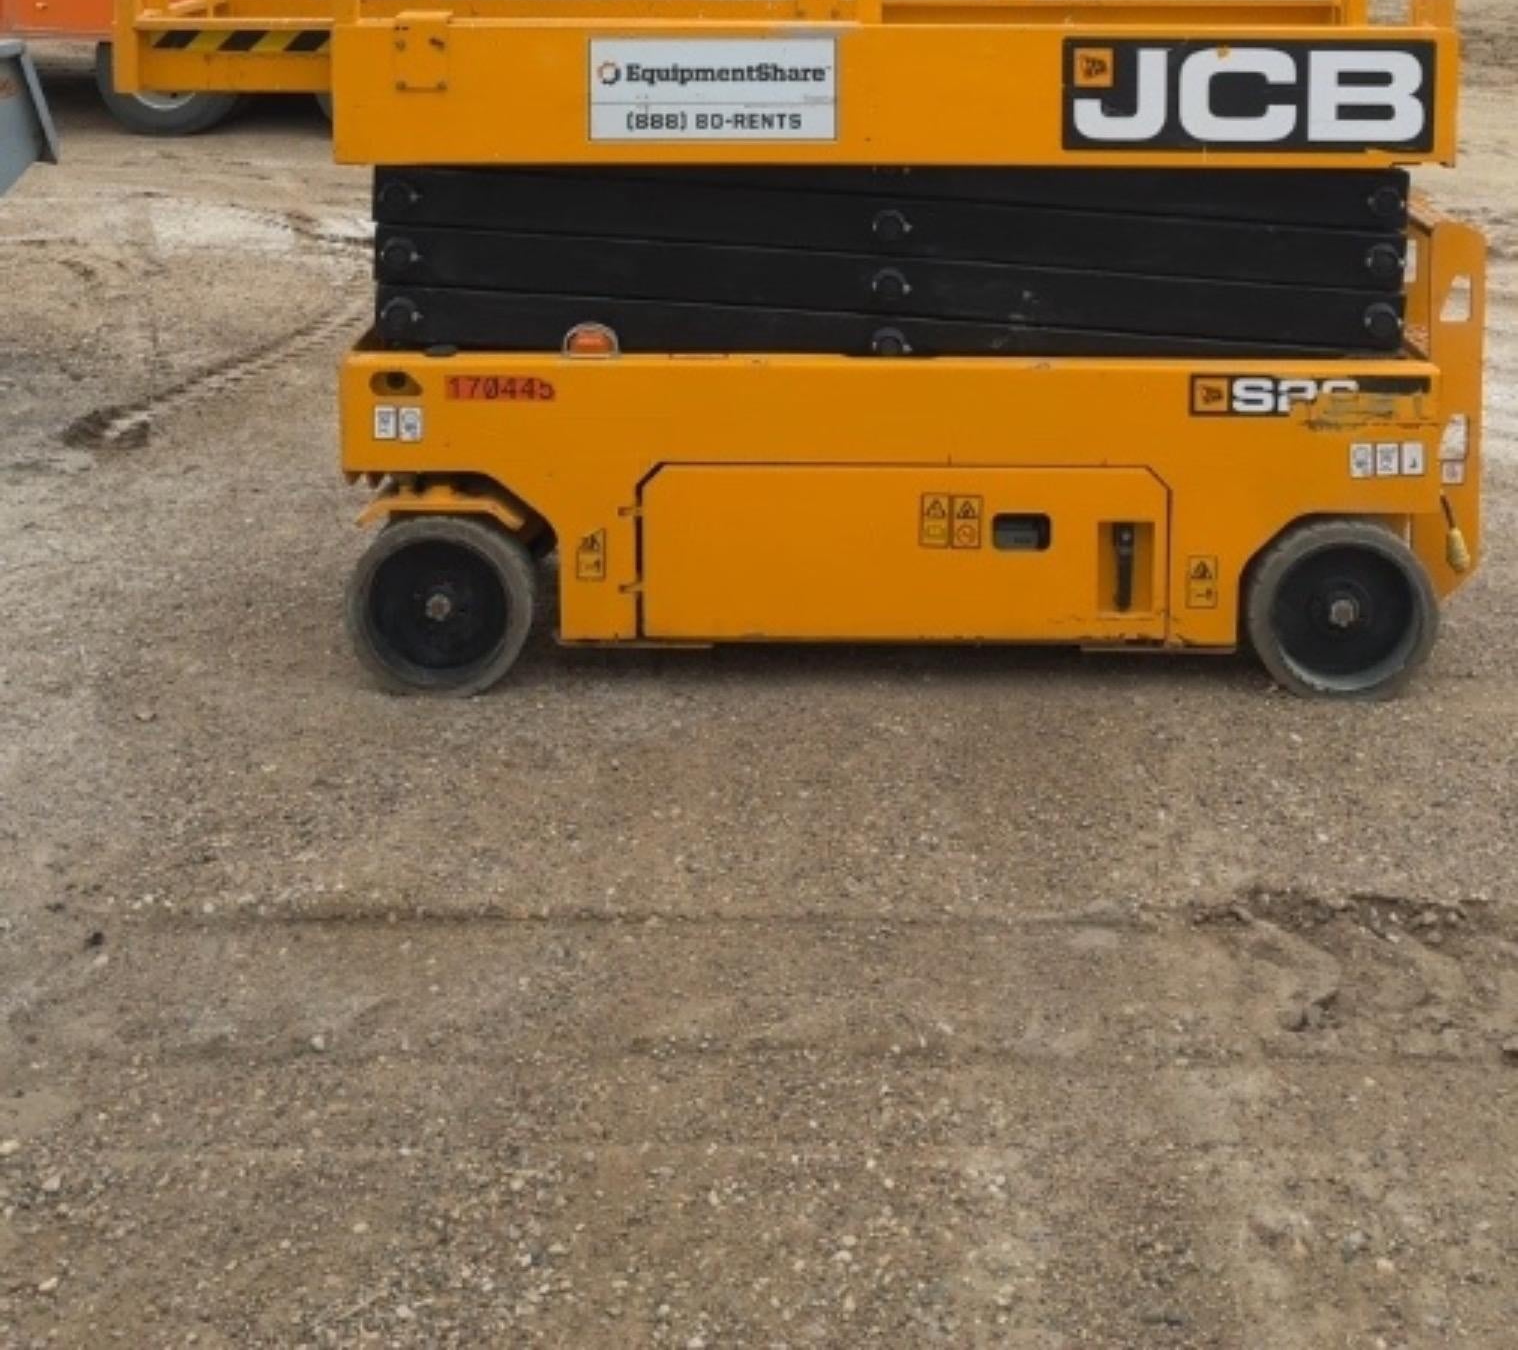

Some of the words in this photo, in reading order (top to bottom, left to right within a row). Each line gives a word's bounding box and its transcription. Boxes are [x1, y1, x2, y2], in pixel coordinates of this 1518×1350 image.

[625, 63, 827, 85] EquipmentShare
[1073, 47, 1425, 142] JCB
[626, 111, 687, 132] (888)
